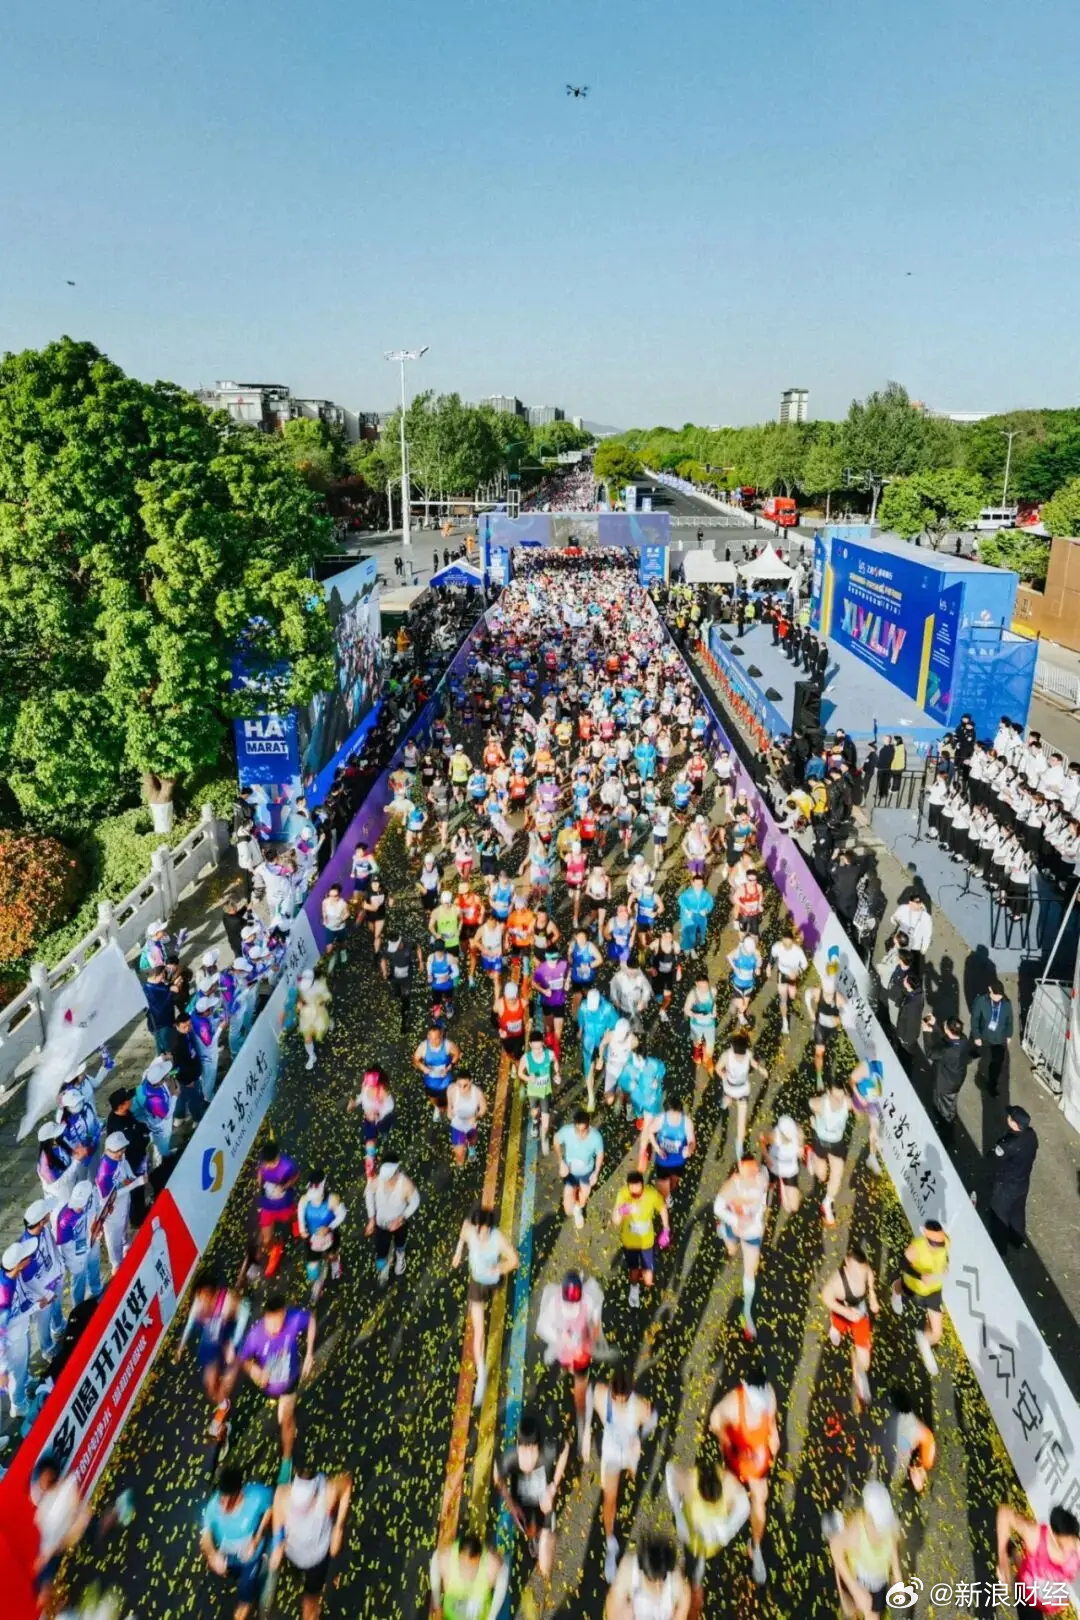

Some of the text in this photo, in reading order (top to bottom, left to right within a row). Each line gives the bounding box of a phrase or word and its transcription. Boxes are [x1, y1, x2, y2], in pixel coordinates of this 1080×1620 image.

[222, 1049, 268, 1147] 江苏银行
[883, 1092, 937, 1202] 江苏银行
[52, 1277, 148, 1464] 多喝开水好
